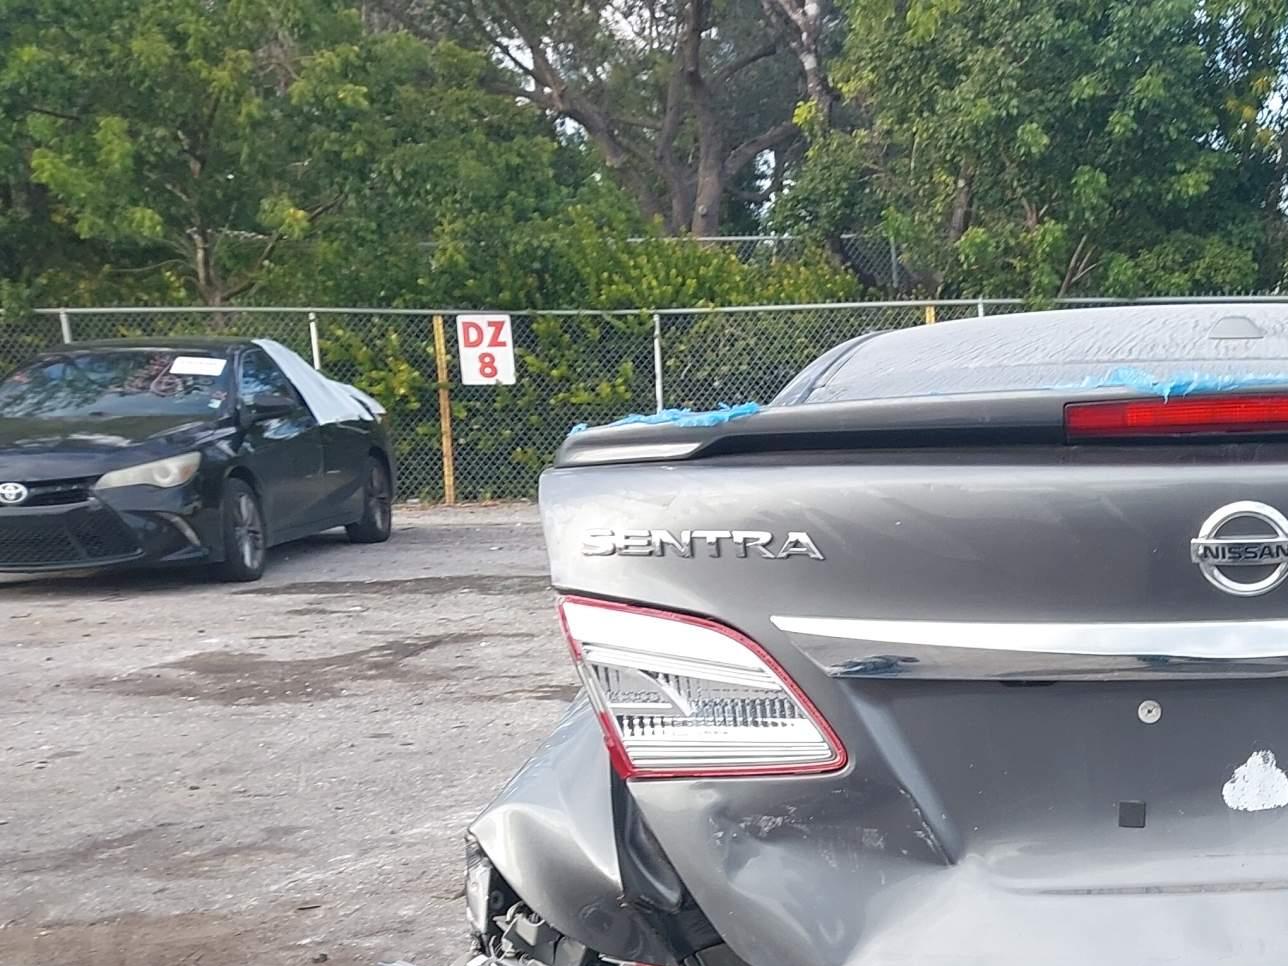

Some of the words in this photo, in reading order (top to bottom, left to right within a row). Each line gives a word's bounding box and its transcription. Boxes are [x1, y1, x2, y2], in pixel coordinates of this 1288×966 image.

[461, 320, 507, 348] DZ
[478, 352, 498, 378] 8
[583, 528, 826, 561] SENTRA
